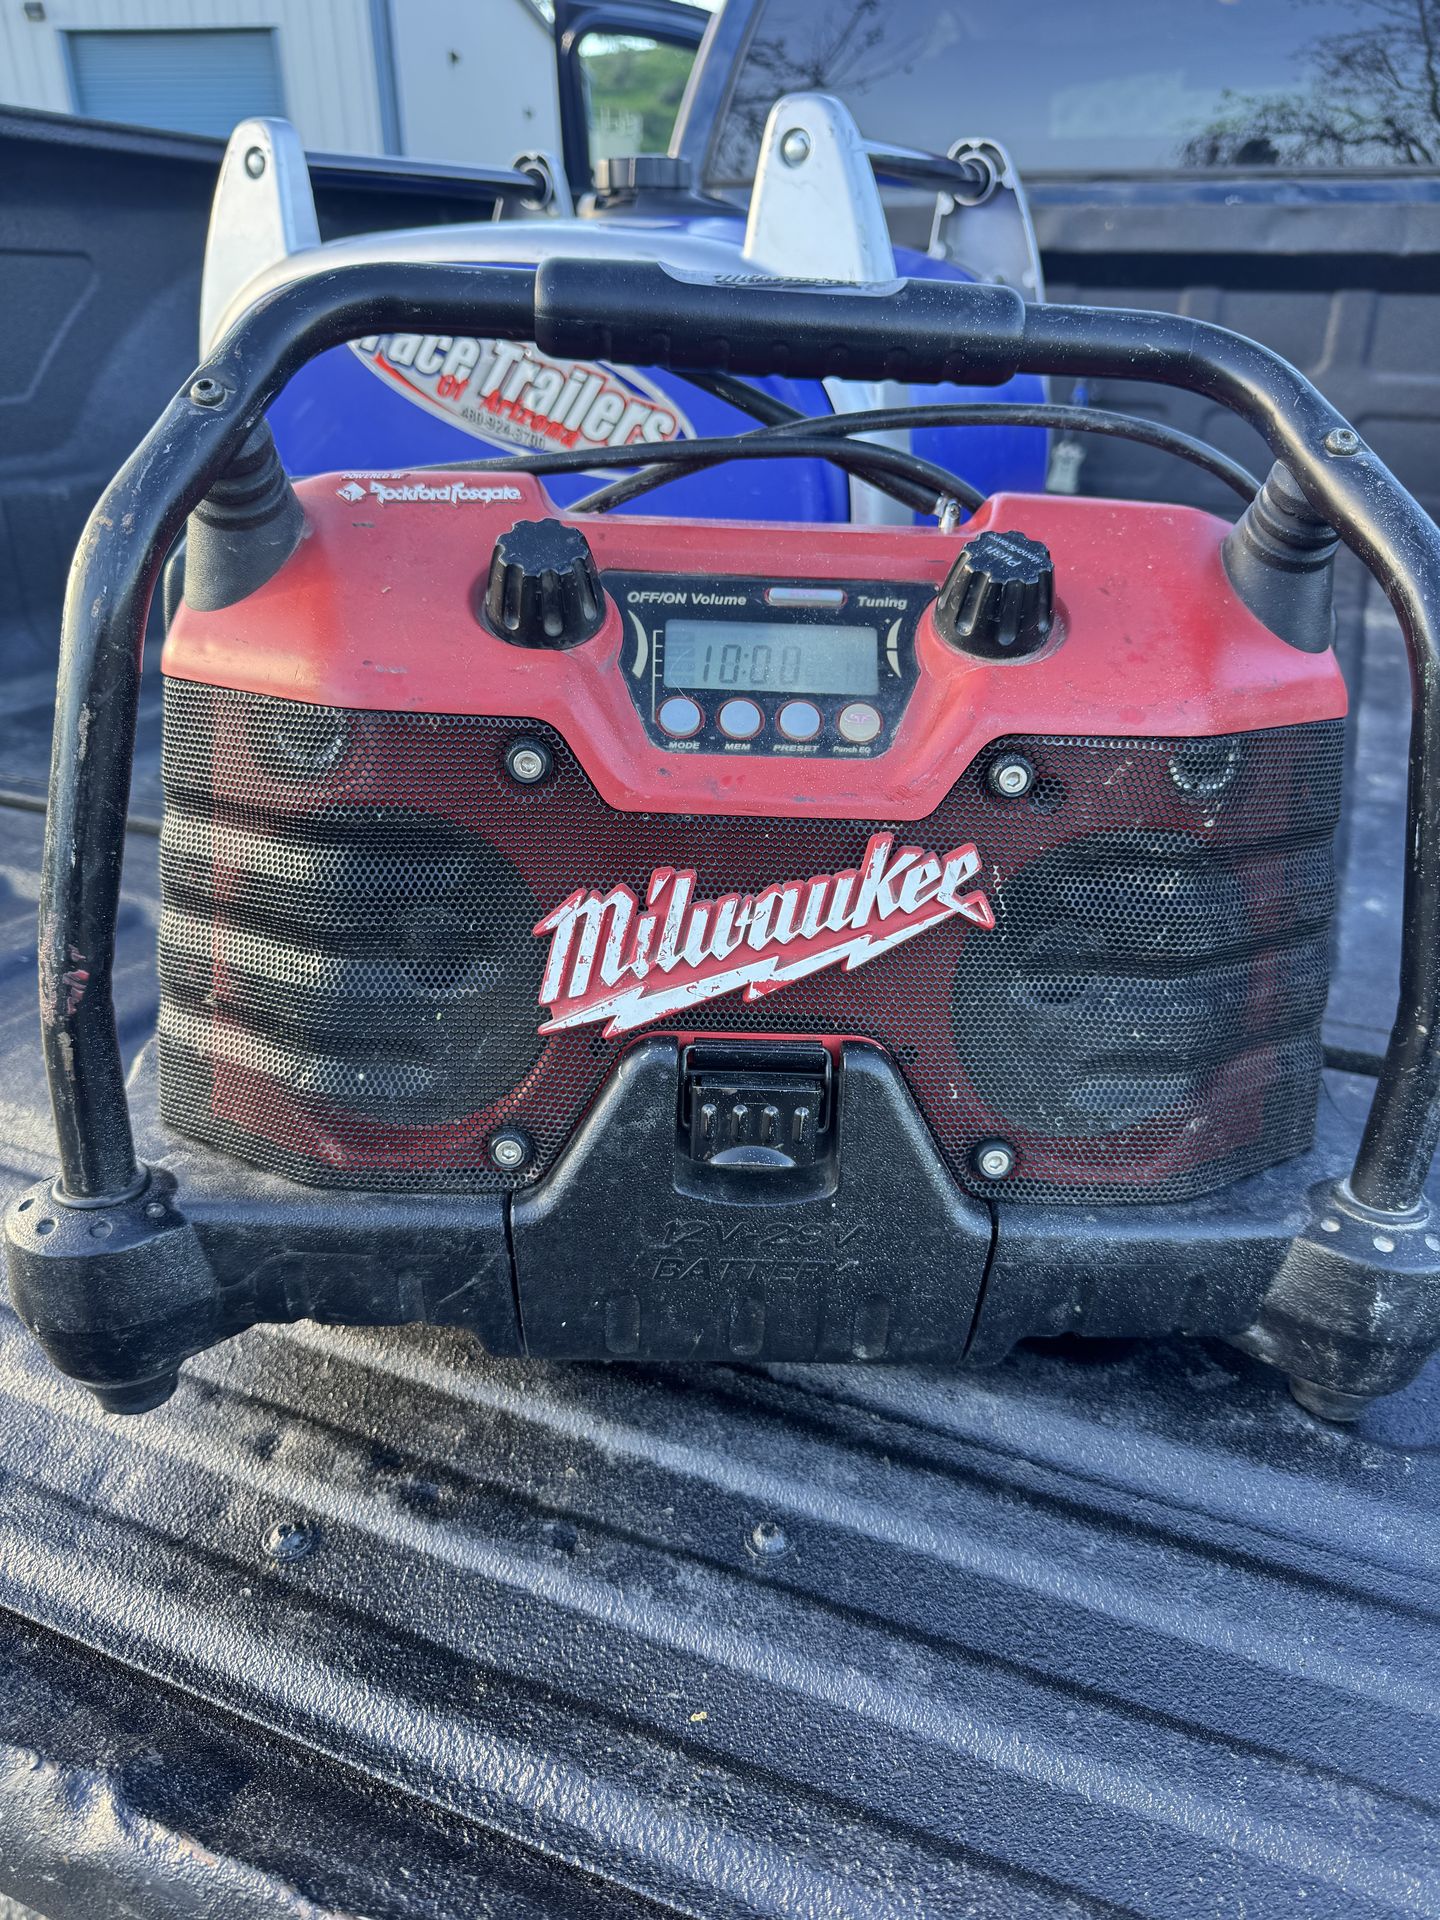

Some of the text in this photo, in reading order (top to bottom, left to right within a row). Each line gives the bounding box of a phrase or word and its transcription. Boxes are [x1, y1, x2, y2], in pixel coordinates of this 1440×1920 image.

[480, 339, 676, 447] Trailers
[482, 388, 579, 448] Arizona
[627, 591, 747, 606] OFF/ON Volume
[857, 596, 908, 610] Tuning
[702, 644, 801, 685] 10:00
[668, 741, 700, 750] MODE
[724, 743, 751, 751] MEM
[773, 744, 819, 752] PRESET
[833, 745, 872, 754] Punch EQ
[534, 832, 990, 1010] Milwaukee
[651, 1256, 860, 1282] BATTERY
